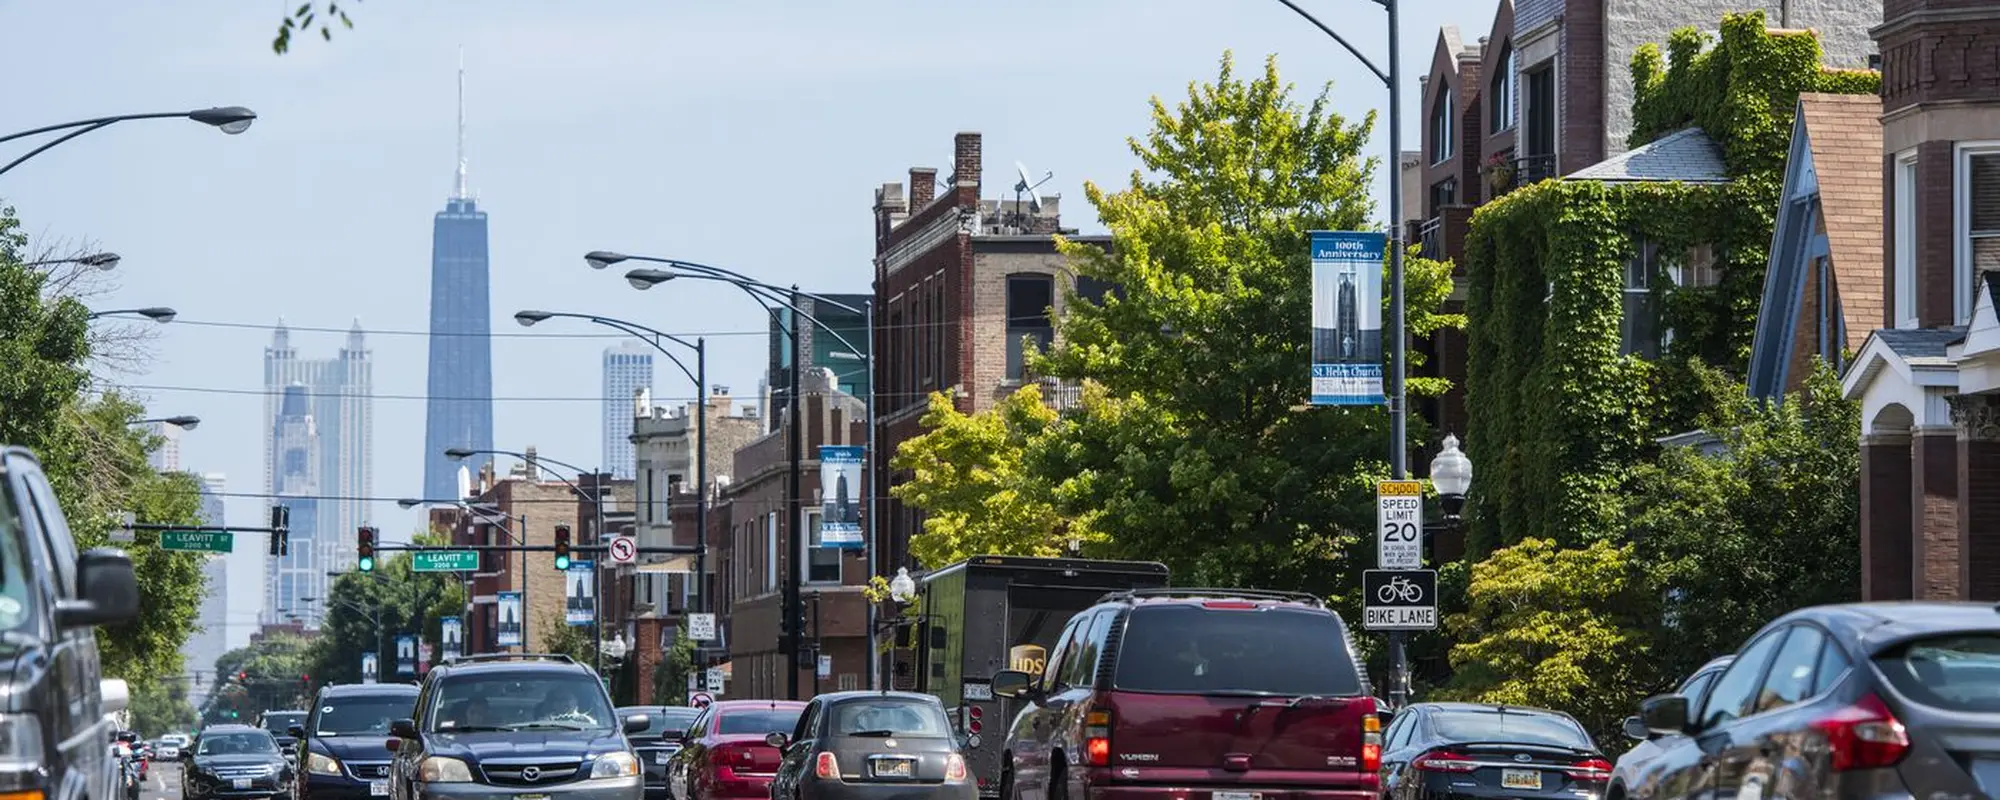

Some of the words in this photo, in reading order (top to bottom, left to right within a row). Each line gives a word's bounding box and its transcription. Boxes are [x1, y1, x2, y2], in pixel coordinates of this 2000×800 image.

[1335, 241, 1364, 250] 100th
[1318, 249, 1381, 260] Anniversary
[1326, 366, 1350, 377] Helen
[1351, 366, 1382, 377] Church
[1381, 484, 1418, 494] SCHOOL
[1382, 499, 1418, 509] SPEED
[1386, 510, 1413, 521] LIMIT
[1384, 522, 1417, 542] 20
[176, 534, 214, 542] LEAVITT
[427, 553, 461, 562] LEAVITT
[1368, 609, 1395, 623] BIKE
[1400, 609, 1432, 623] LANE
[1120, 753, 1159, 761] YUKON
